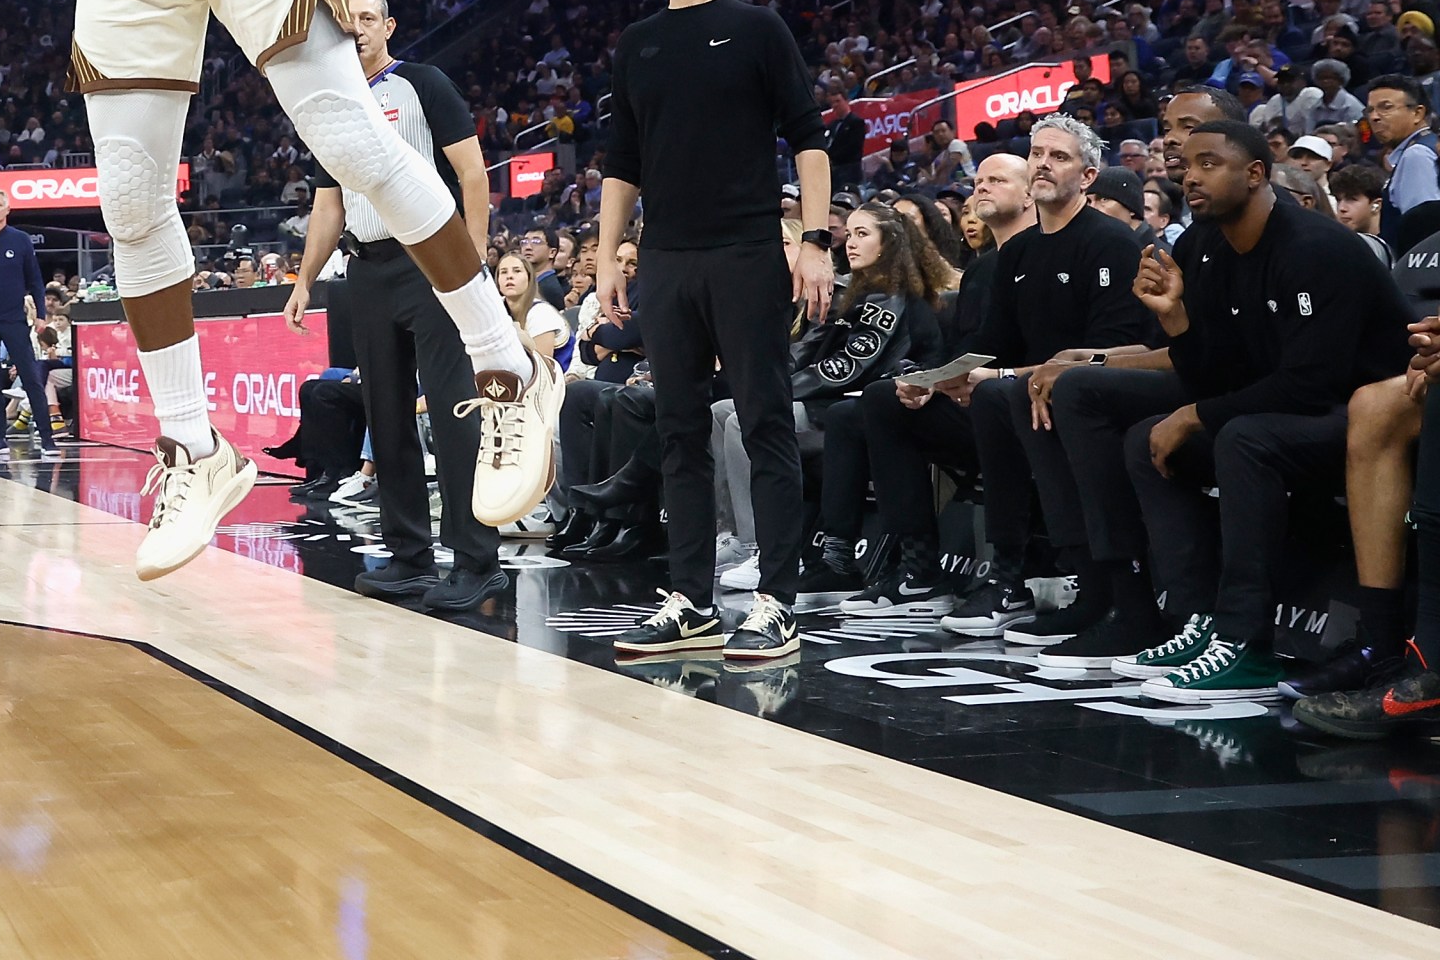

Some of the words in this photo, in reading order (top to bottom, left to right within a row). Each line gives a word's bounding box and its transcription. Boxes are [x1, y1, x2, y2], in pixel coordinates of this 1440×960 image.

[860, 302, 896, 331] 78
[87, 367, 140, 403] ORACLE
[233, 373, 320, 417] ORACL
